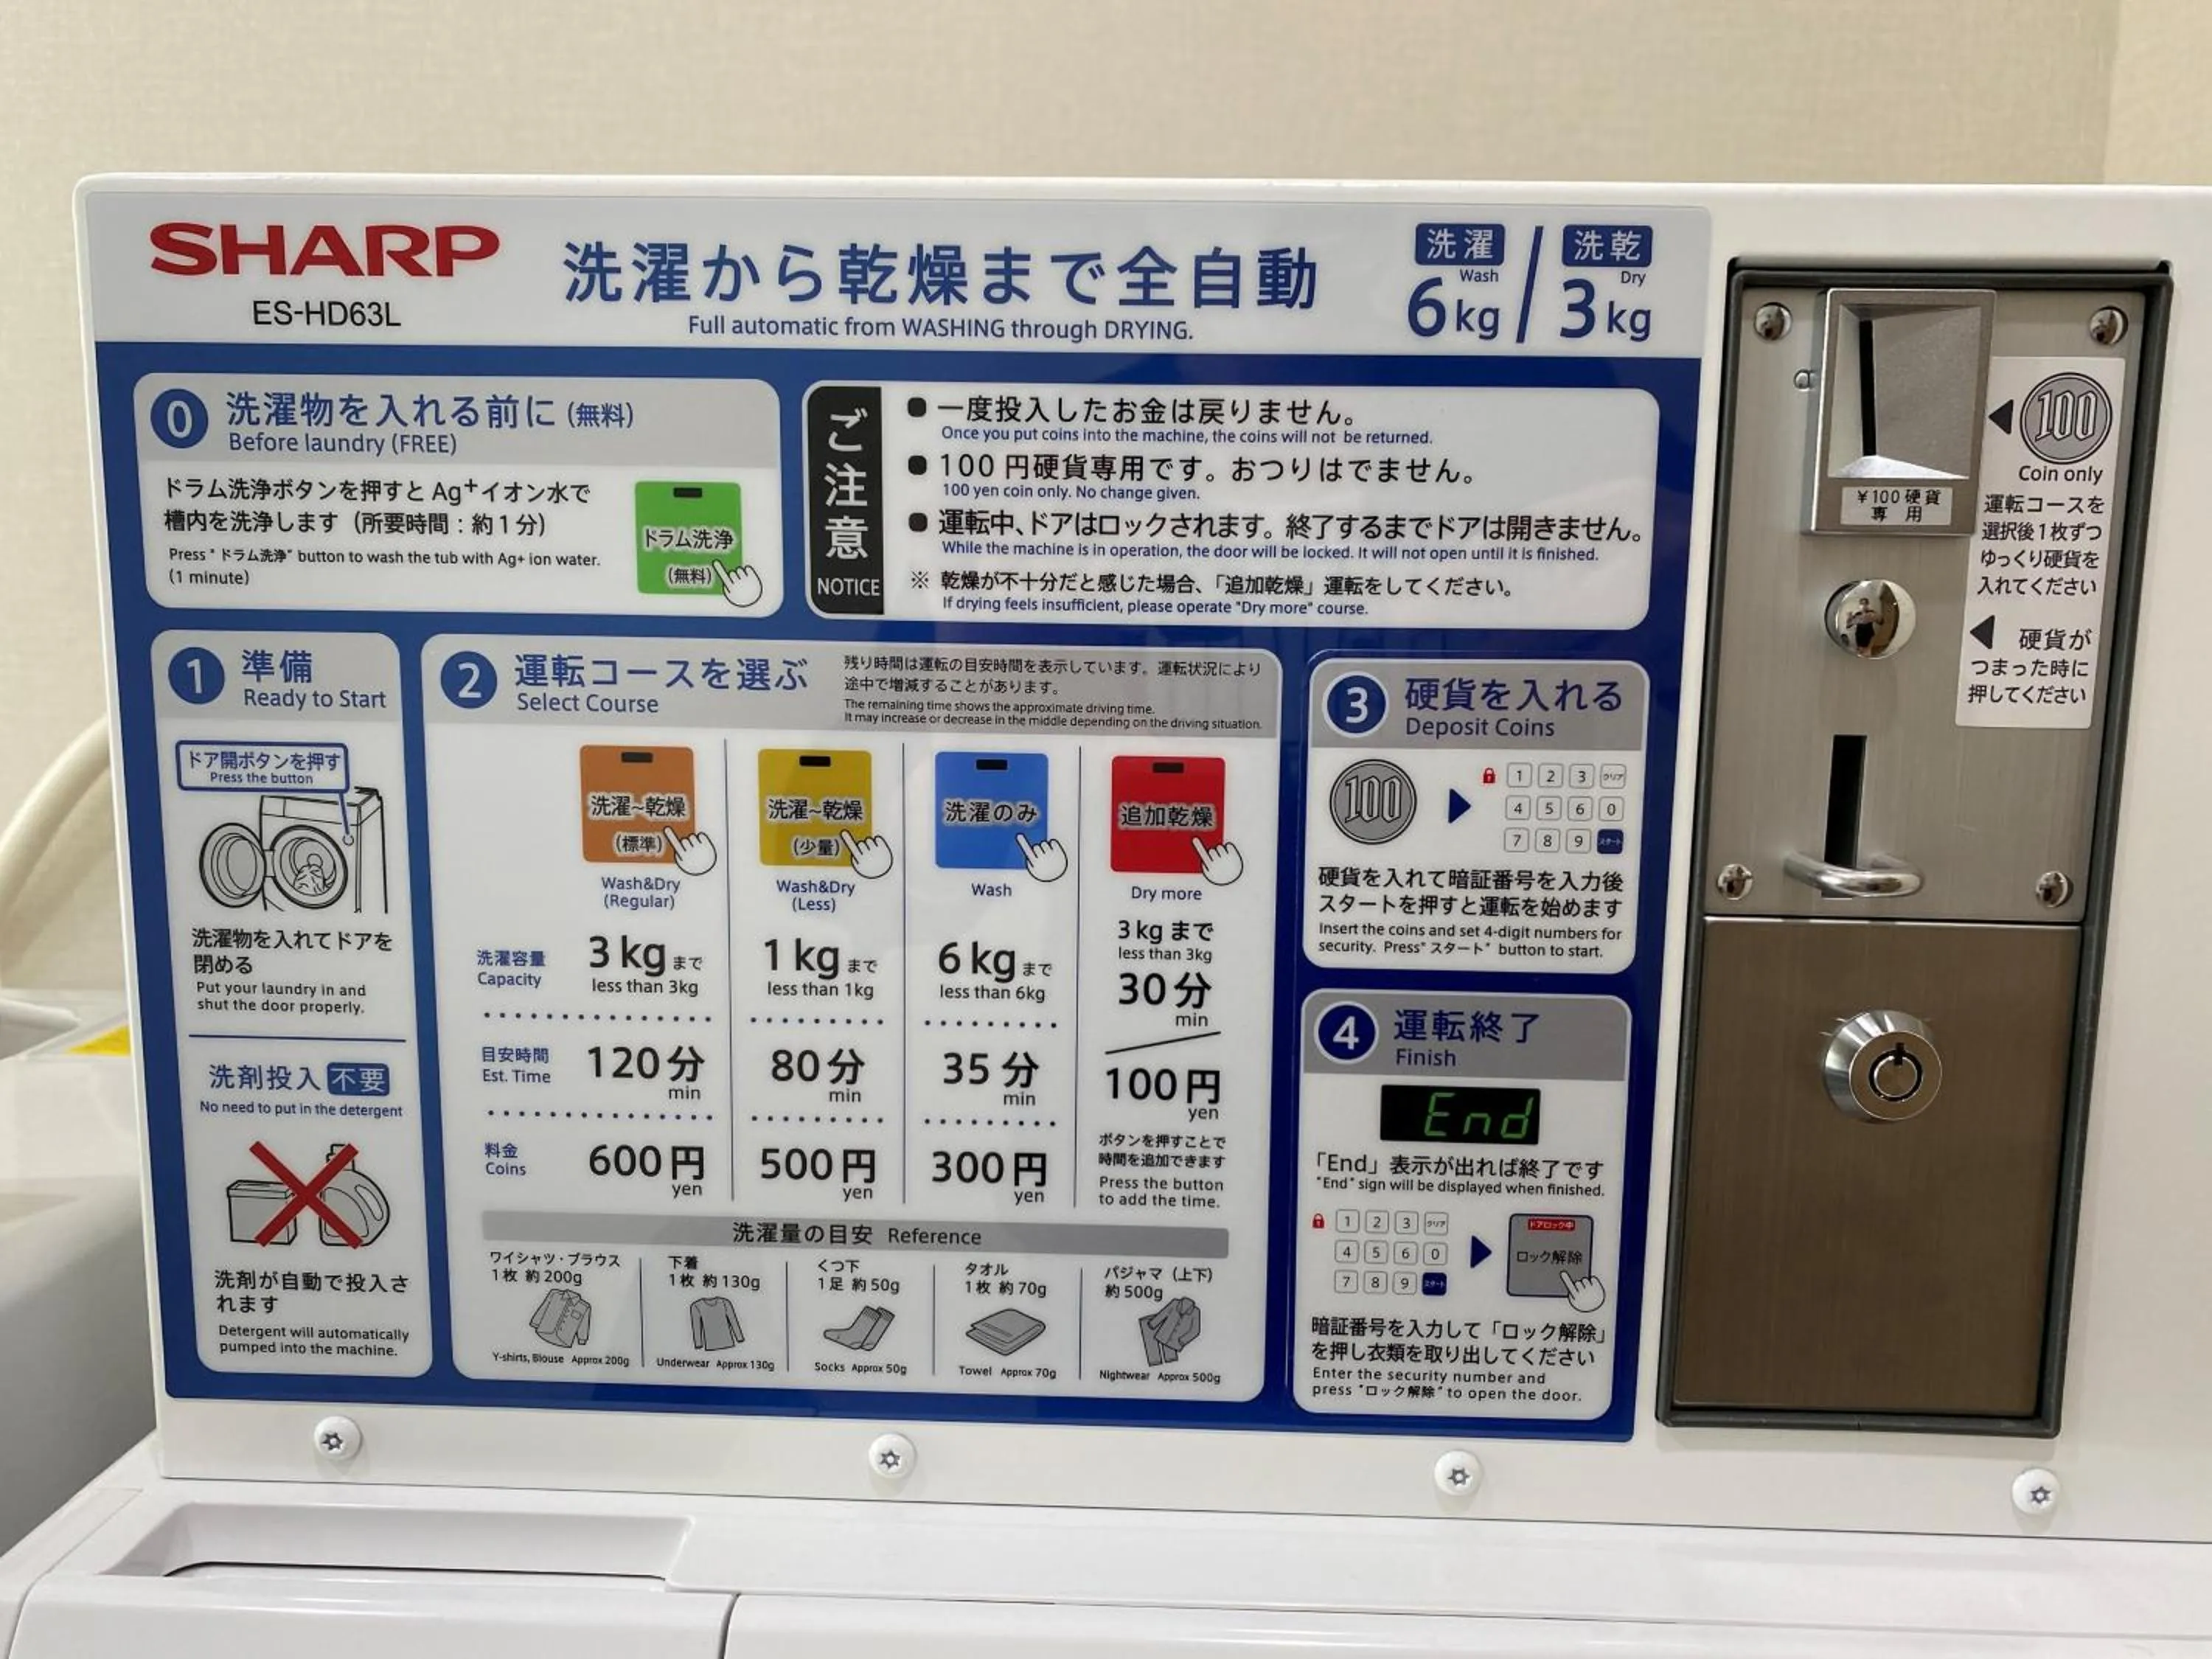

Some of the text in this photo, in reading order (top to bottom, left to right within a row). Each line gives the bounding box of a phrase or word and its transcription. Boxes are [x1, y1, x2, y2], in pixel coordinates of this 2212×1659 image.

[150, 222, 500, 277] SHARP
[1427, 229, 1493, 260] 洗濯
[1574, 229, 1641, 262] 洗乾
[563, 240, 1317, 310] 洗濯から乾燥まで全自動
[1459, 268, 1499, 282] Wash
[1621, 271, 1646, 288] Dry
[253, 300, 402, 327] ES-HD63L
[689, 315, 1193, 344] Full automatic from WASHING through DRYING.
[167, 400, 192, 439] 0
[226, 391, 555, 429] 洗濯物を入れる前に
[2034, 389, 2098, 442] 100
[229, 431, 456, 457] Before laundry (FREE)
[824, 408, 869, 560] ご注意
[2018, 465, 2104, 486] Coin only
[943, 483, 1200, 502] 100 yen coin only. No change given.
[1983, 493, 2105, 514] 運転コースを
[646, 529, 734, 550] ドラム洗浄
[1980, 549, 2100, 569] ゆっくり硬貨を
[817, 577, 880, 597] NOTICE
[1977, 576, 2096, 597] 入れてください
[2019, 628, 2093, 651] 硬貨が
[187, 658, 202, 694] 1
[241, 649, 312, 684] 準備
[514, 653, 808, 691] 運転コースを選ぶ
[1971, 658, 2089, 678] つまった時に
[458, 662, 481, 698] 2
[244, 688, 386, 710] Ready to Start
[517, 692, 658, 713] Select Course
[1405, 678, 1621, 712] 硬貨を入れる
[1967, 684, 2086, 704] 押してください
[845, 698, 1155, 717] The remaining time shows the approximate driving time.
[1346, 686, 1368, 723] 3
[1406, 717, 1555, 740] Deposit Coins
[189, 751, 341, 771] ドア開ボタンを押す
[210, 771, 313, 785] Press the button
[1343, 775, 1404, 824] 100
[946, 801, 1040, 825] 洗濯のみ
[1121, 805, 1213, 827] 追加乾燥
[601, 876, 681, 894] Wash&Dry
[776, 880, 855, 897] Wash&Dry
[971, 883, 1012, 897] Wash
[1131, 886, 1203, 902] Dry more
[604, 894, 675, 911] (Regular)
[792, 897, 836, 914] (Less)
[191, 927, 392, 952] 洗濯物を入れてドアを
[1319, 922, 1622, 941] Insert the coins and set 4-digit numbers for
[194, 955, 253, 975] 閉める
[476, 949, 546, 967] 洗濯容量
[477, 971, 542, 989] Capacity
[592, 978, 622, 993] less
[626, 978, 664, 994] than
[1175, 1012, 1208, 1027] min
[1394, 1009, 1540, 1043] 運転終了
[1332, 1015, 1360, 1051] 4
[481, 1046, 549, 1064] 目安時間
[1396, 1048, 1456, 1067] Finish
[209, 1064, 321, 1091] 洗剤投入
[330, 1068, 385, 1093] 不要
[483, 1068, 551, 1084] Est. Time
[668, 1085, 700, 1100] min
[200, 1100, 403, 1119] No need to put in the detergent
[1188, 1107, 1219, 1123] yen
[1424, 1091, 1534, 1139] End
[484, 1142, 518, 1158] 料金
[485, 1161, 526, 1176] Coins
[672, 1184, 703, 1199] yen
[732, 1221, 981, 1245] 洗濯量の目安 Reference
[1517, 1251, 1583, 1265] ロック解除
[965, 1262, 1009, 1276] タオル
[218, 1324, 409, 1343] Detergent will automatically
[656, 1357, 775, 1372] Underwear Approx 130g
[959, 1366, 1057, 1380] Towel Approx 70g
[1313, 1366, 1545, 1385] Enter the security number and
